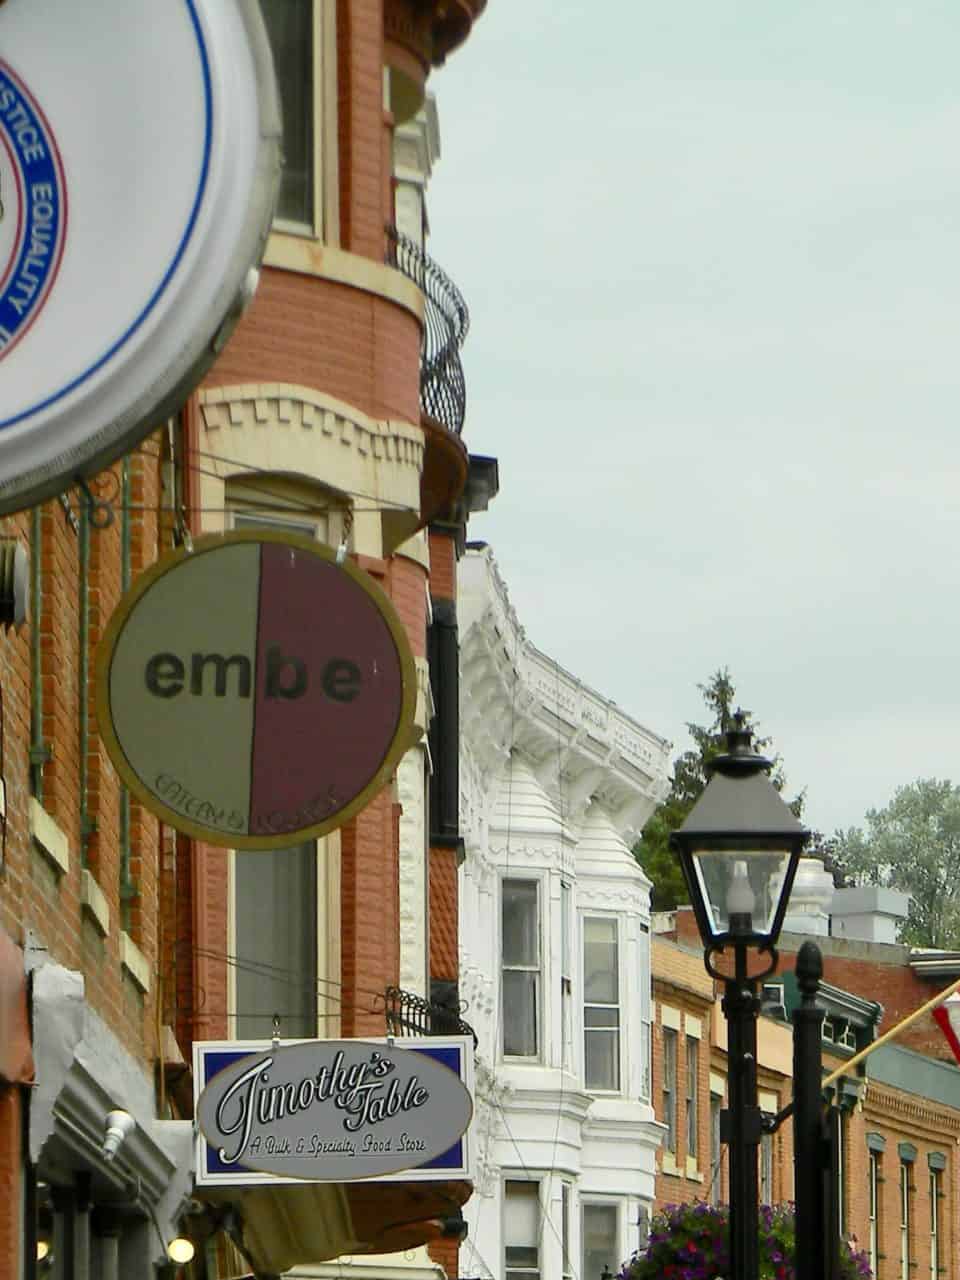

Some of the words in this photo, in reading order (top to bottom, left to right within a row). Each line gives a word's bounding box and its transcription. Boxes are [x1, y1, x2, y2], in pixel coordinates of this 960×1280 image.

[0, 79, 45, 164] STICE
[8, 183, 53, 315] EQUALITY
[145, 646, 362, 703] embe
[217, 1050, 395, 1164] Timothy's
[344, 1077, 430, 1132] Table
[250, 1136, 261, 1154] A
[265, 1136, 290, 1154] Bulk
[296, 1136, 305, 1153] &
[306, 1135, 356, 1158] Specialty
[363, 1134, 391, 1152] Food
[399, 1132, 426, 1152] Store
